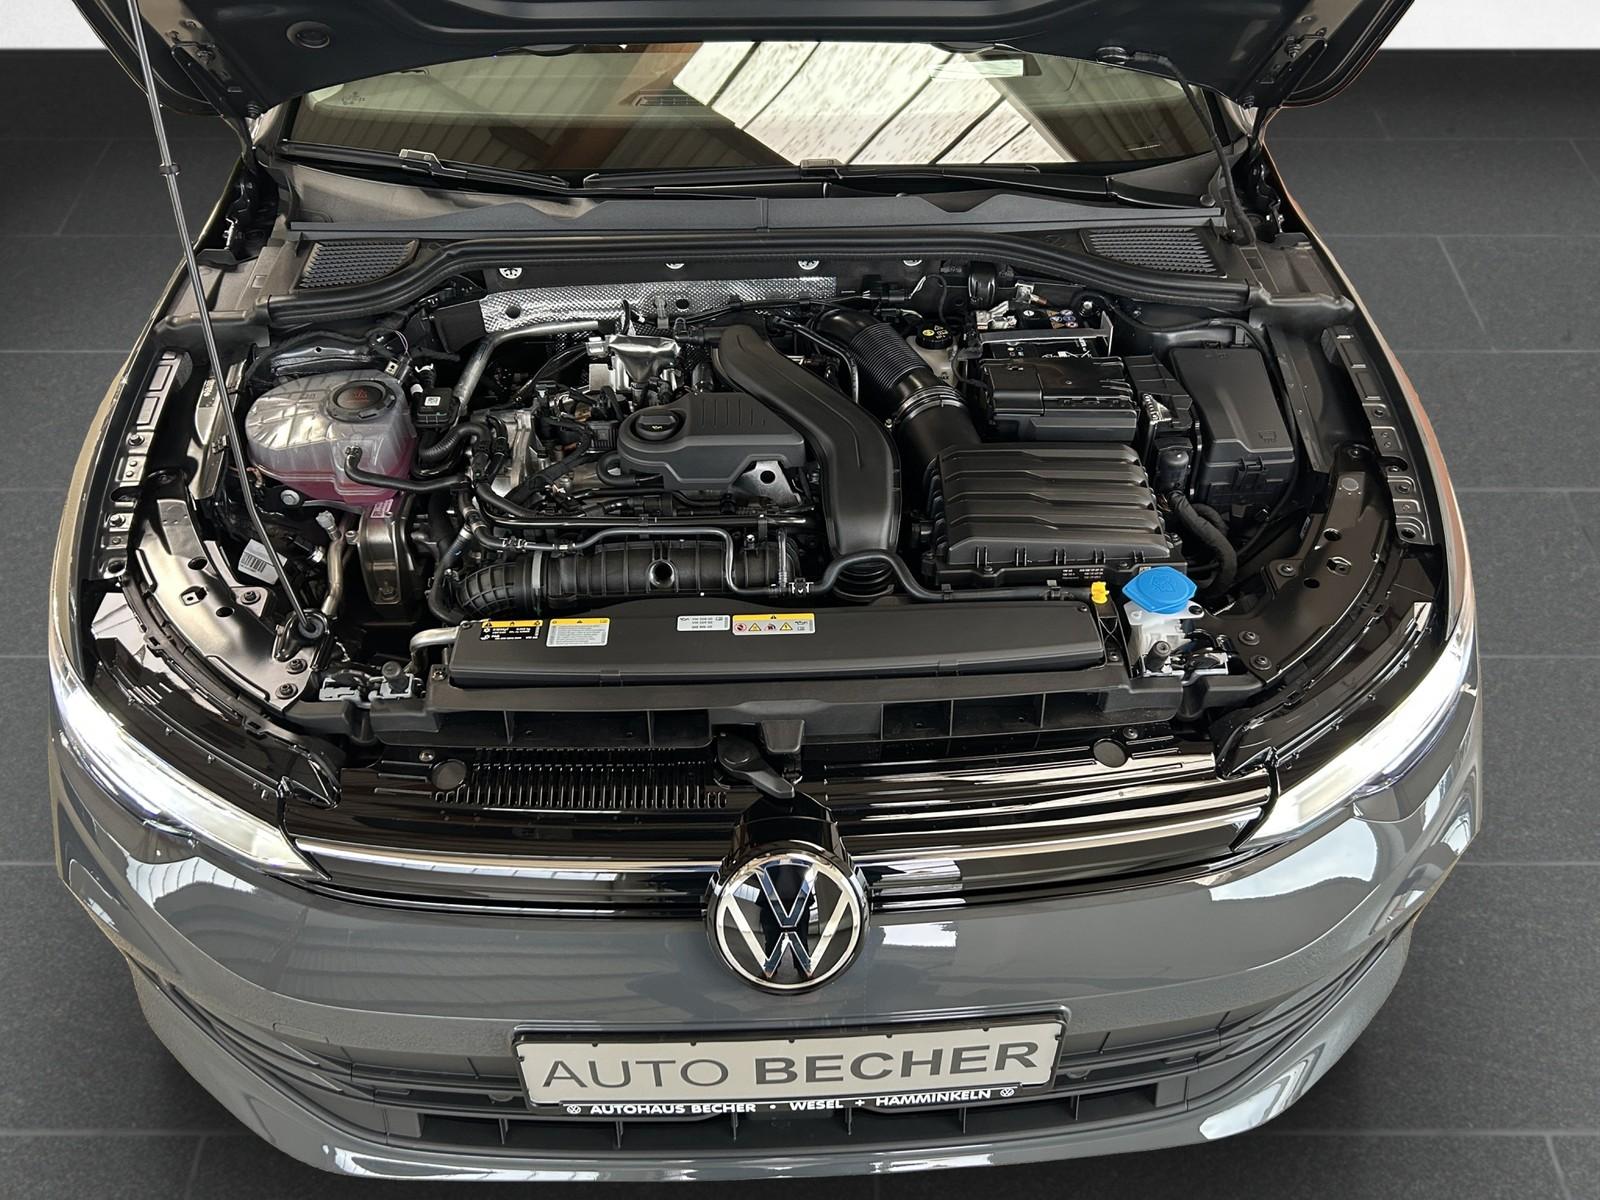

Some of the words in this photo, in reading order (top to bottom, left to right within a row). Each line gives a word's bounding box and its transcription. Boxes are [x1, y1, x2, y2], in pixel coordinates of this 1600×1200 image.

[543, 1059, 729, 1088] AUTO
[755, 1041, 1039, 1085] BECHER
[590, 1104, 686, 1115] AUTOHAUS
[691, 1103, 756, 1113] BECHER
[789, 1100, 844, 1111] WESEL
[875, 1089, 991, 1107] HAMMINKELN
